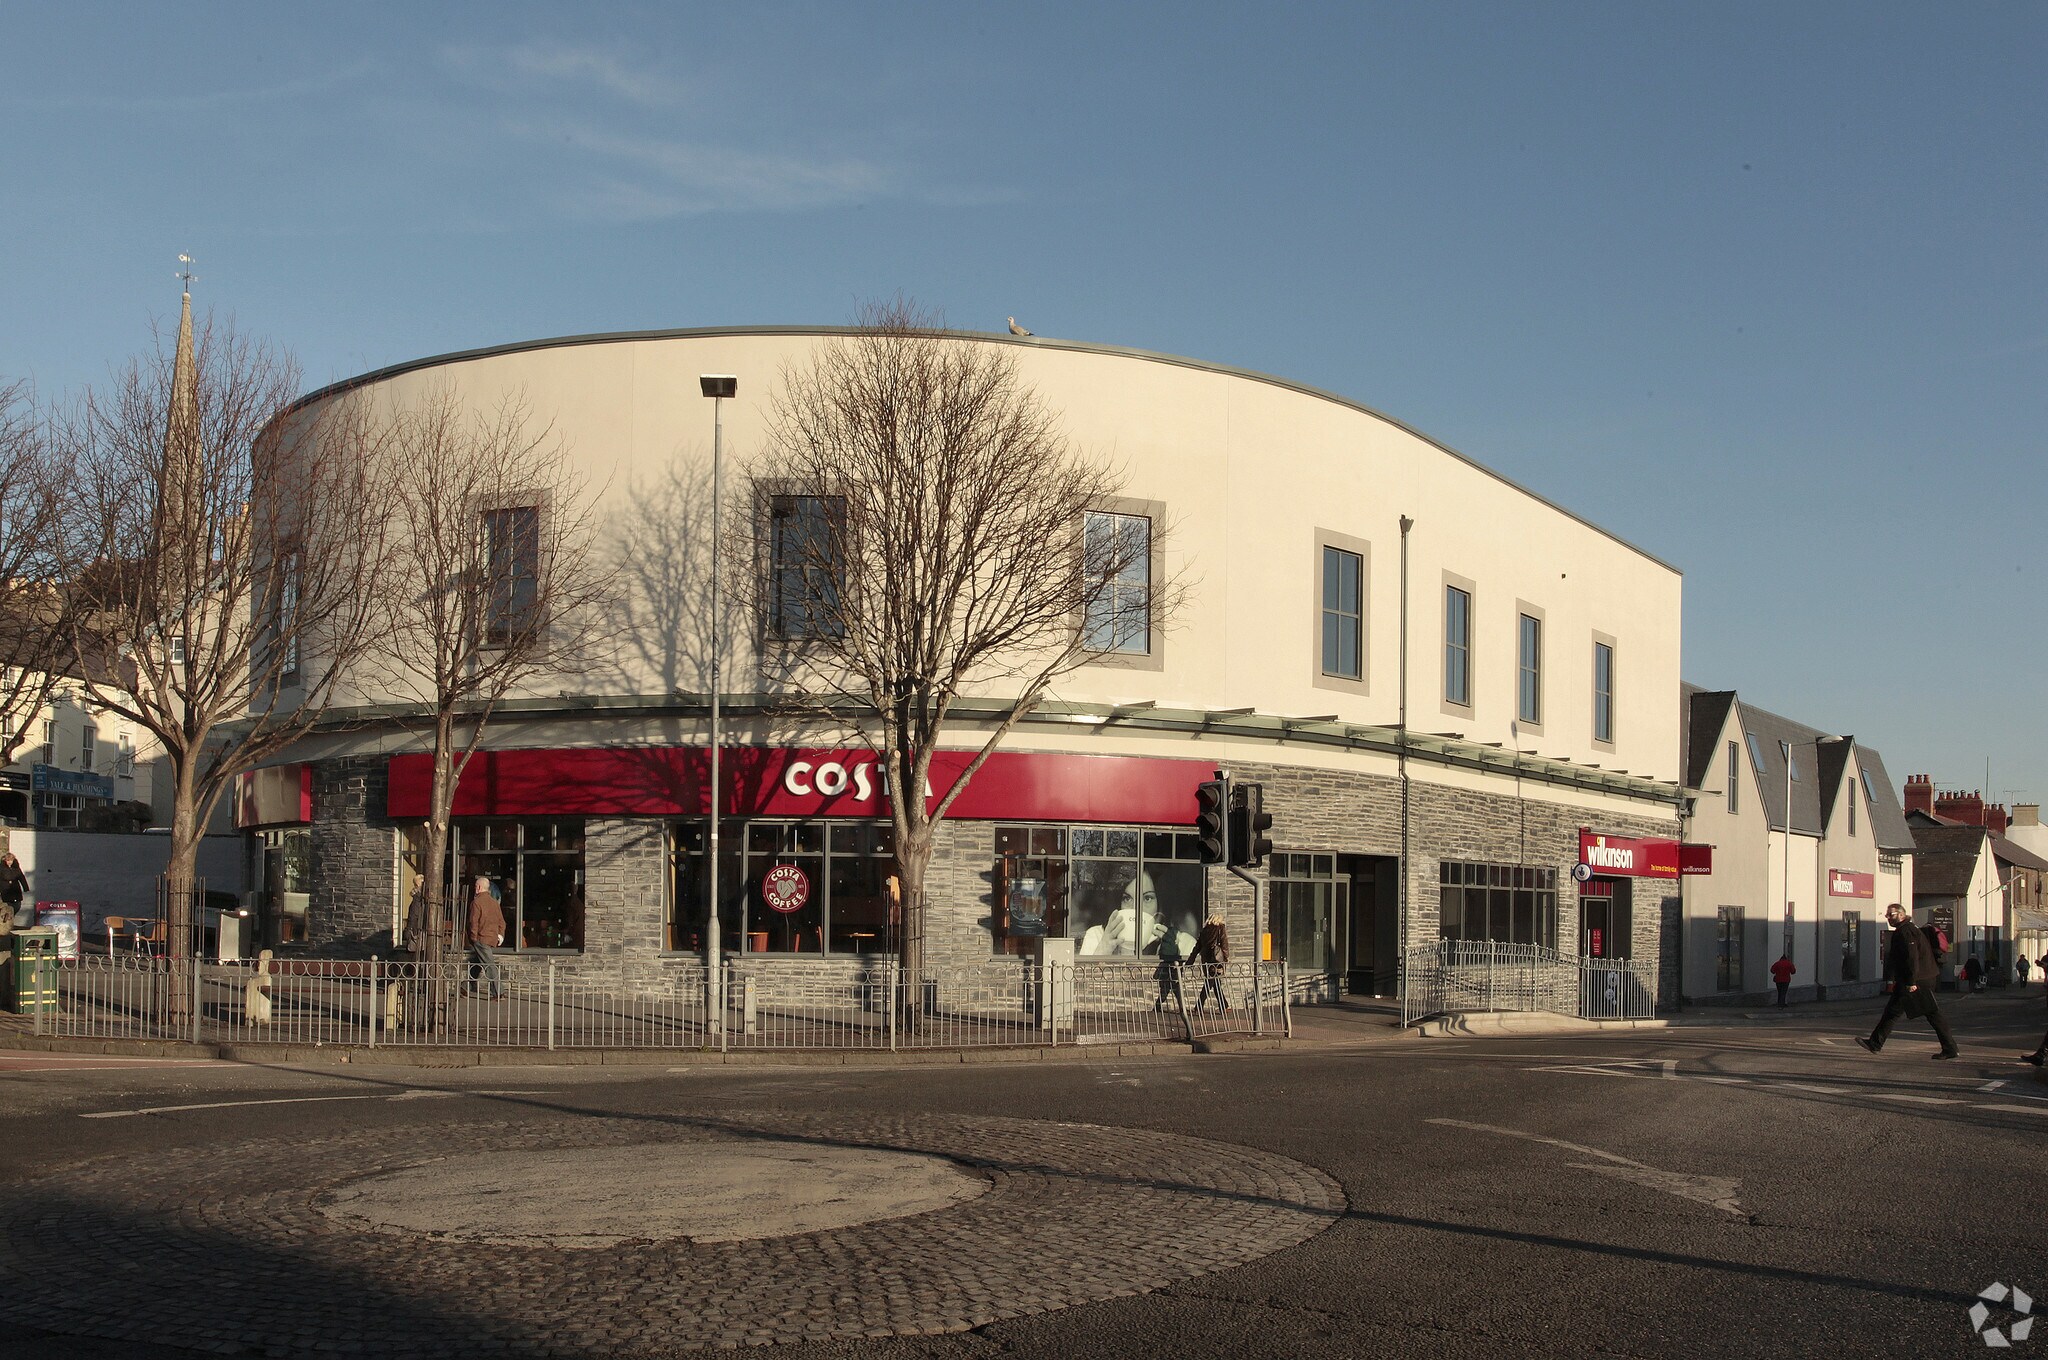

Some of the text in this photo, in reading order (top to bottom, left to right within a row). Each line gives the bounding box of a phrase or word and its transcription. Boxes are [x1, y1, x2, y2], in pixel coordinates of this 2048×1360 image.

[785, 762, 933, 801] COS
[1587, 837, 1633, 869] wilkinson
[770, 869, 800, 881] COSTA
[769, 892, 803, 908] COFFEE
